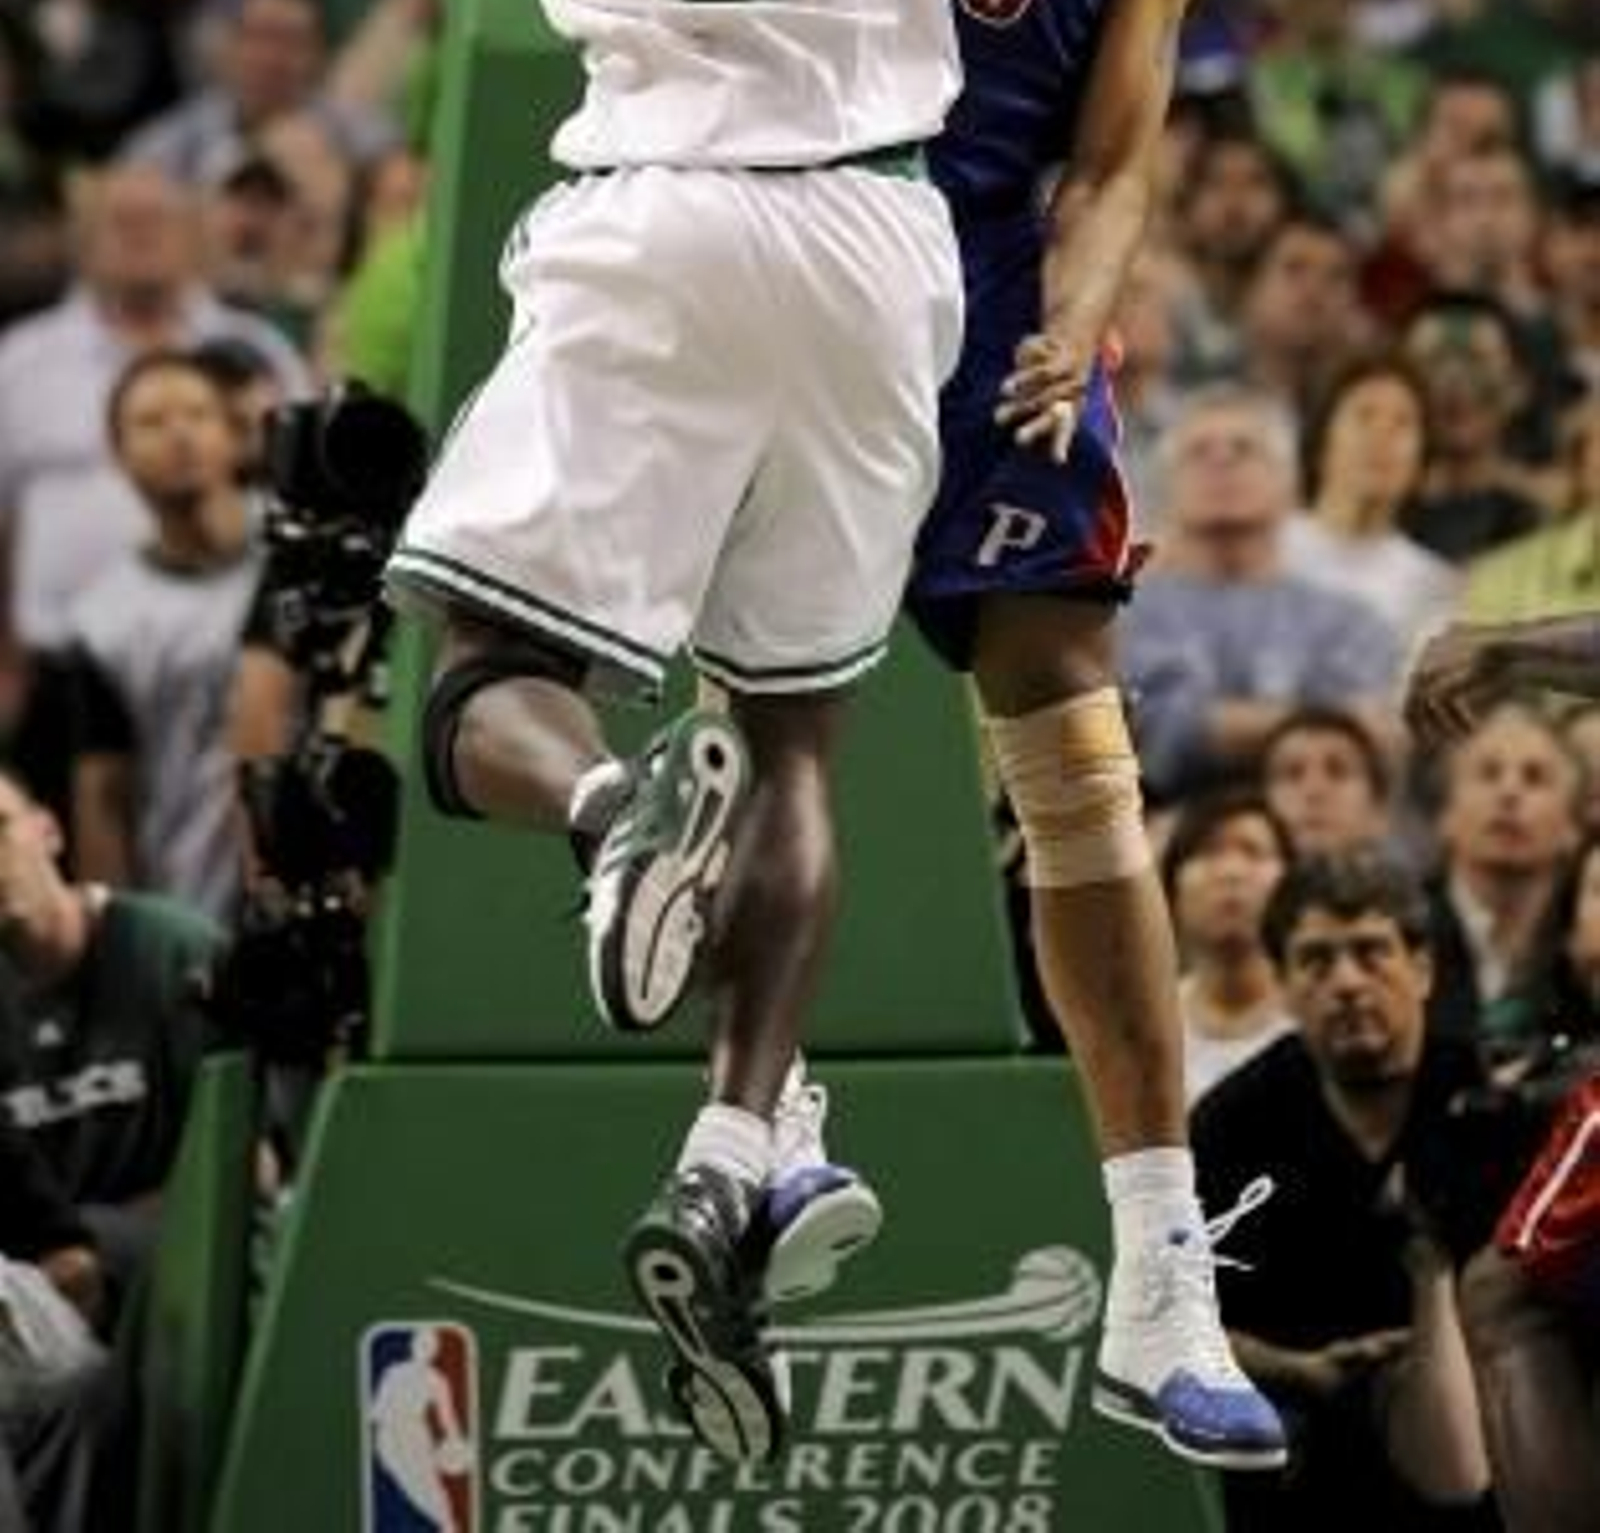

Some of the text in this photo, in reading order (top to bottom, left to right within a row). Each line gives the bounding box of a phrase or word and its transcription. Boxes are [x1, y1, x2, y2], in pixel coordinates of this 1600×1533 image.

[978, 502, 1047, 566] P
[491, 1344, 1083, 1439] EAERN
[494, 1493, 1054, 1533] FINALS 2008
